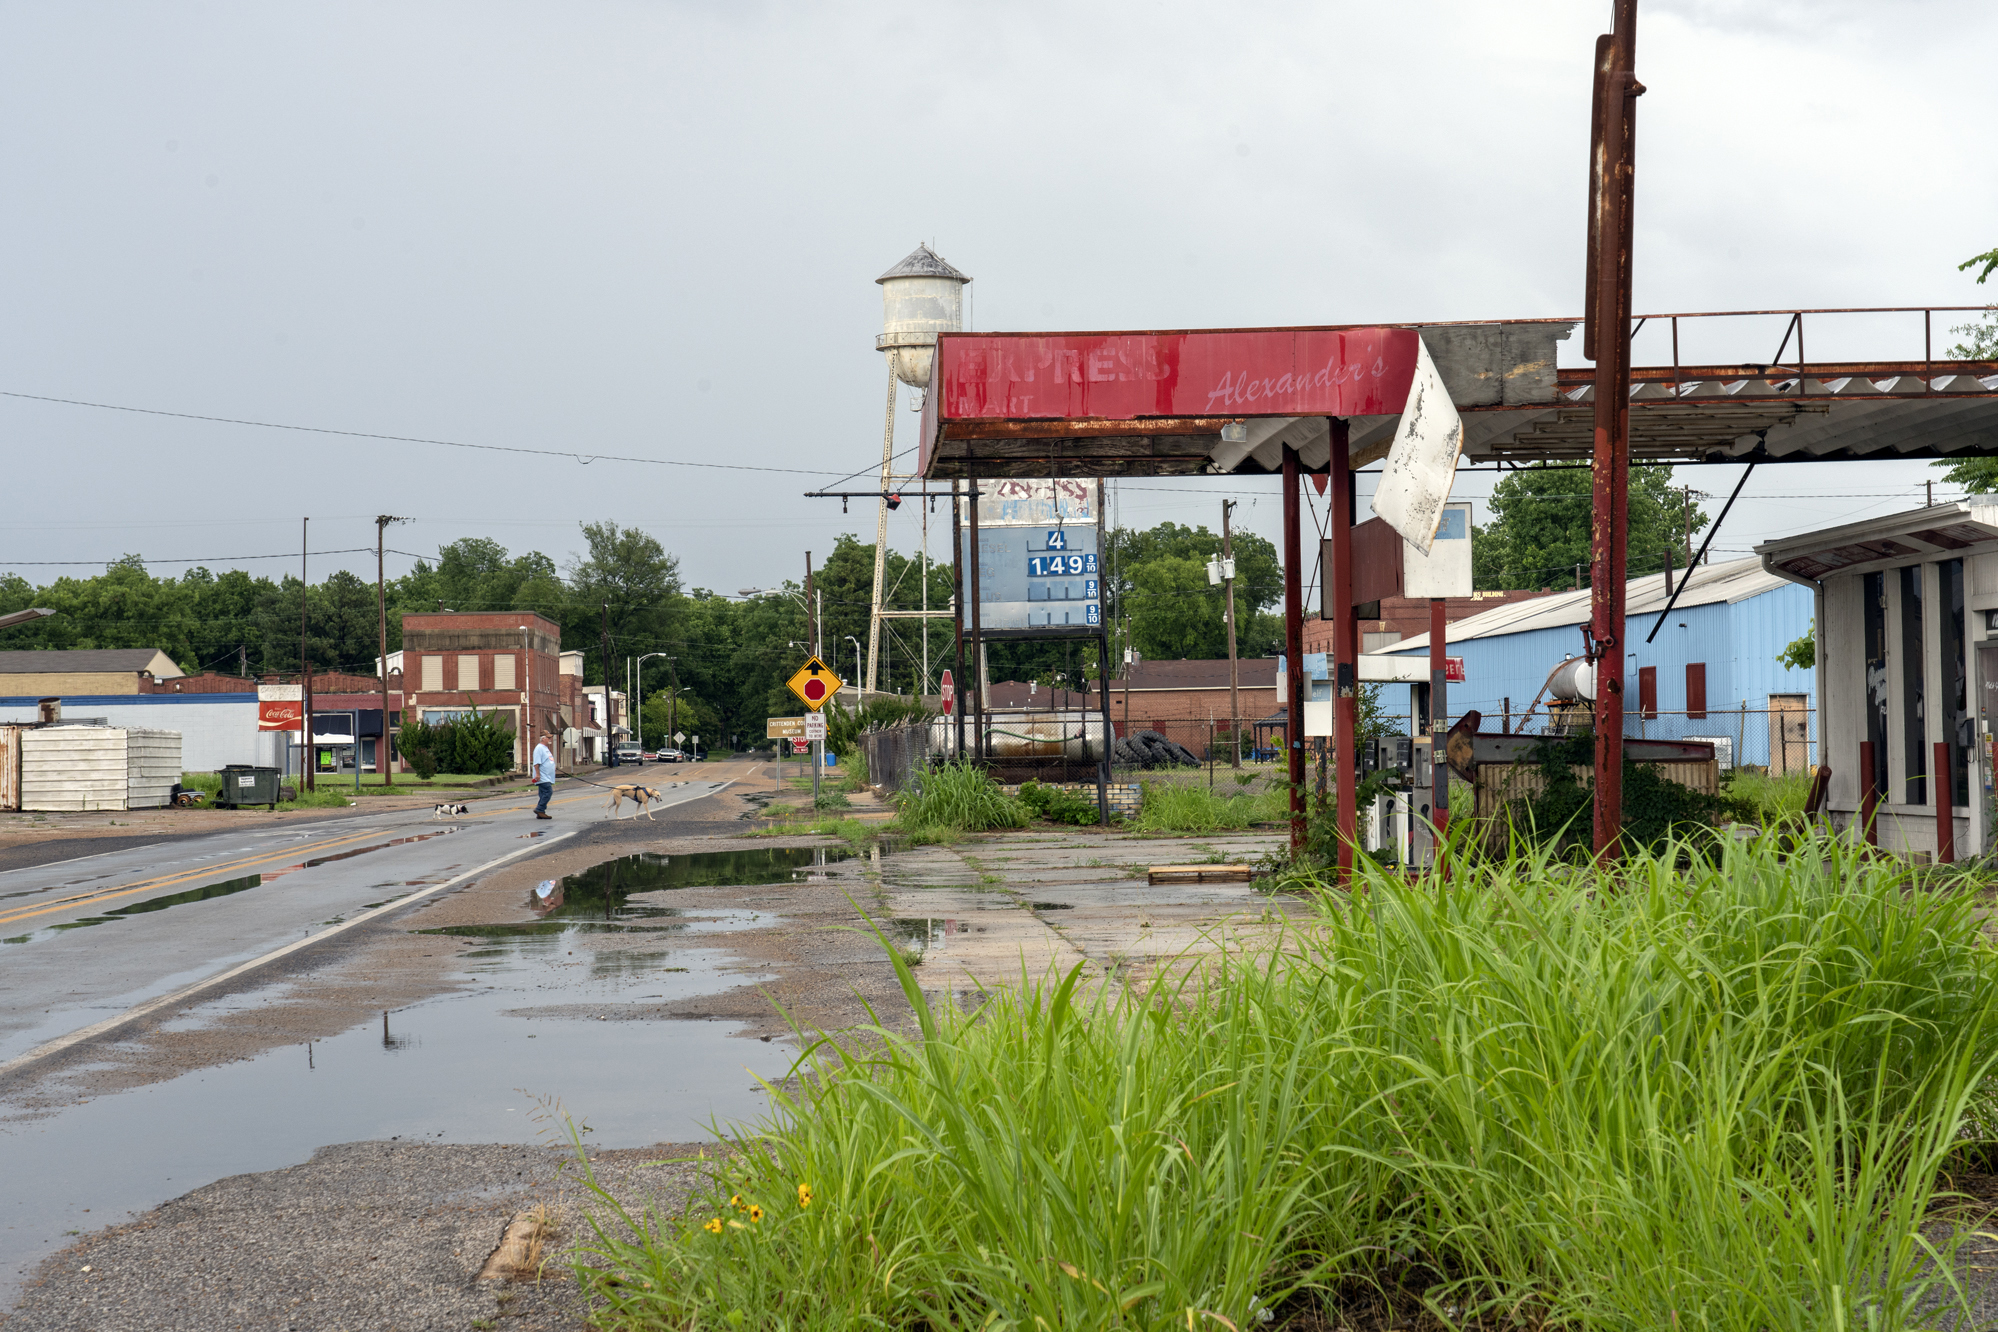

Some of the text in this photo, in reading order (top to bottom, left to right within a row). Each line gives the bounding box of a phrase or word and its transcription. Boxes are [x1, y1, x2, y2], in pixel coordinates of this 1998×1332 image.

[959, 347, 1171, 384] EXPRESS
[1204, 344, 1389, 412] Alexander's
[958, 395, 1034, 415] MART
[979, 543, 1012, 554] ESEL
[1048, 532, 1064, 550] 4
[979, 567, 996, 577] EG
[1031, 556, 1083, 575] 1.49
[942, 684, 953, 701] STOP
[1312, 688, 1323, 698] elf
